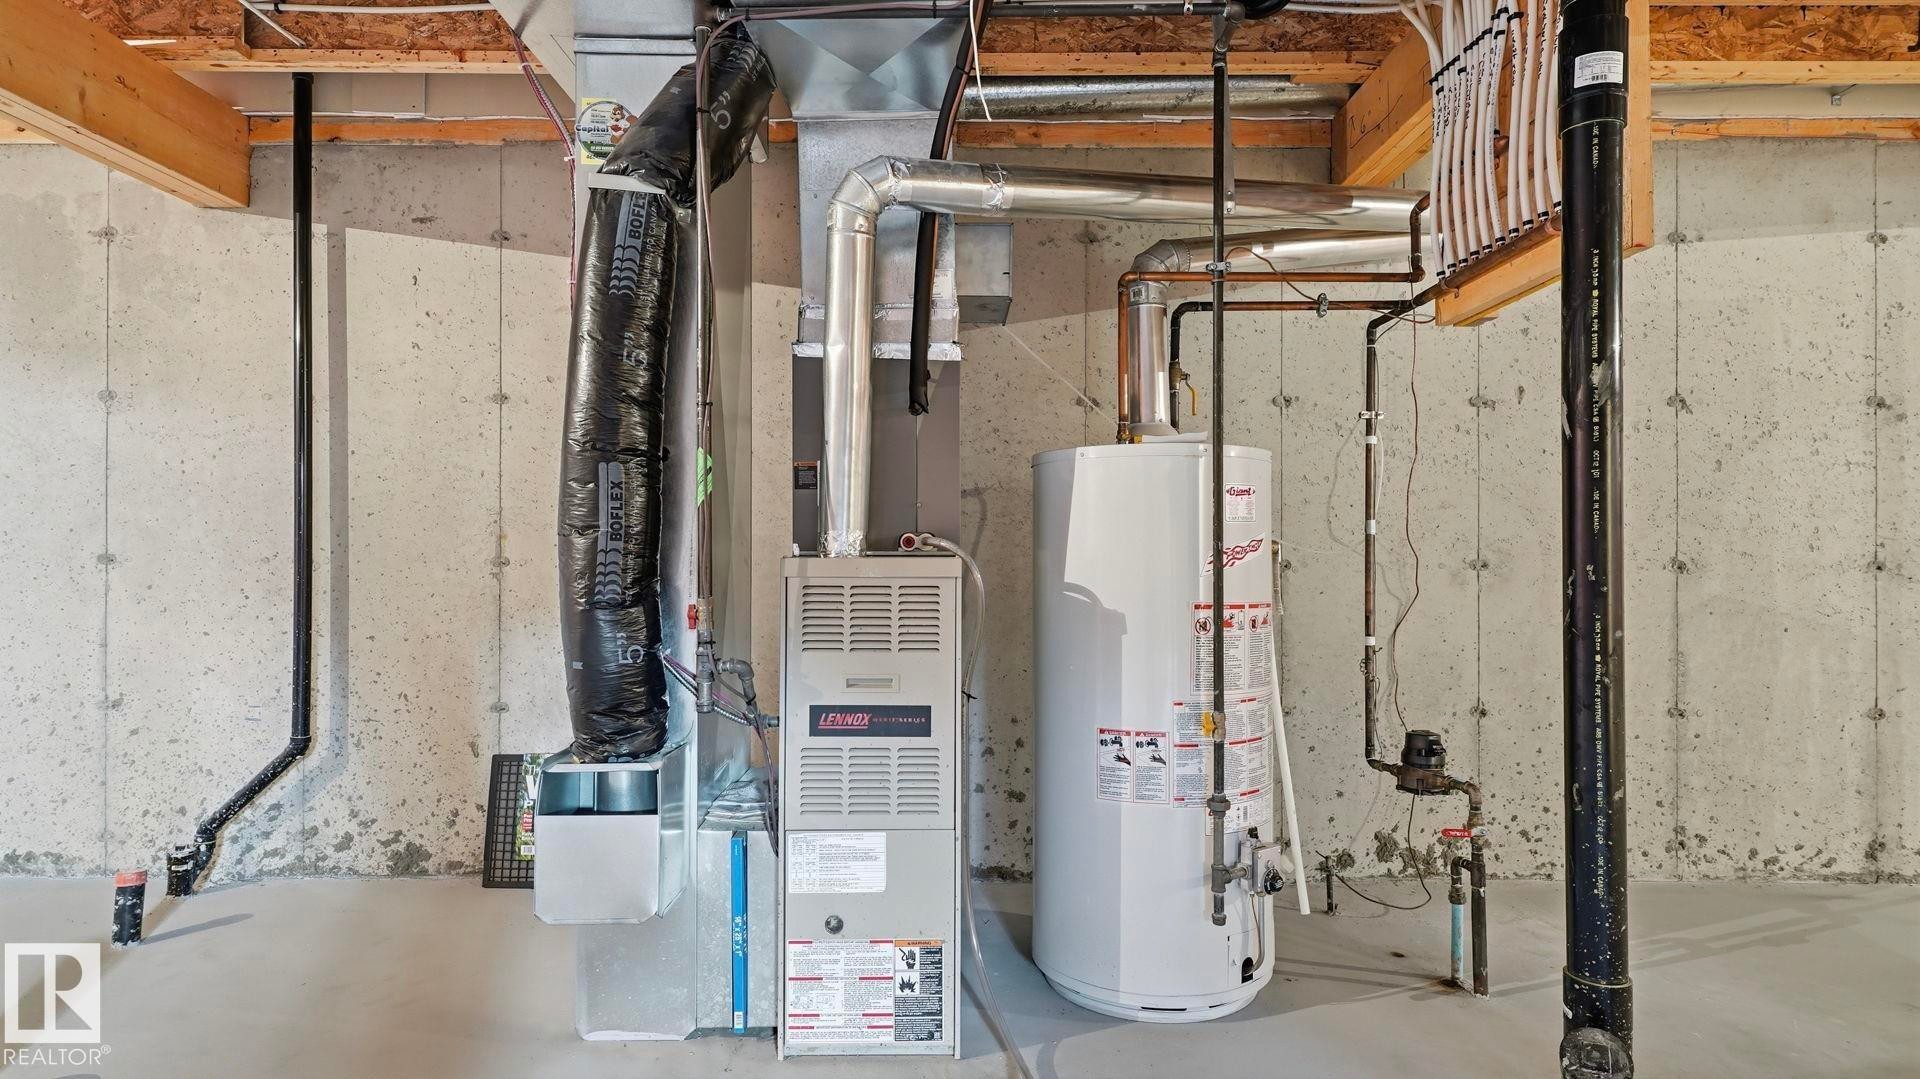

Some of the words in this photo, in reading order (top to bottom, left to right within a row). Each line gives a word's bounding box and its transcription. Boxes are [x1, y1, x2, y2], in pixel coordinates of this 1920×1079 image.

[576, 125, 610, 134] Capital
[628, 192, 646, 240] BOFLE
[1229, 486, 1252, 497] Giant
[608, 480, 622, 542] BOFLEX
[617, 633, 644, 663] 5"
[818, 712, 872, 727] LENNOX
